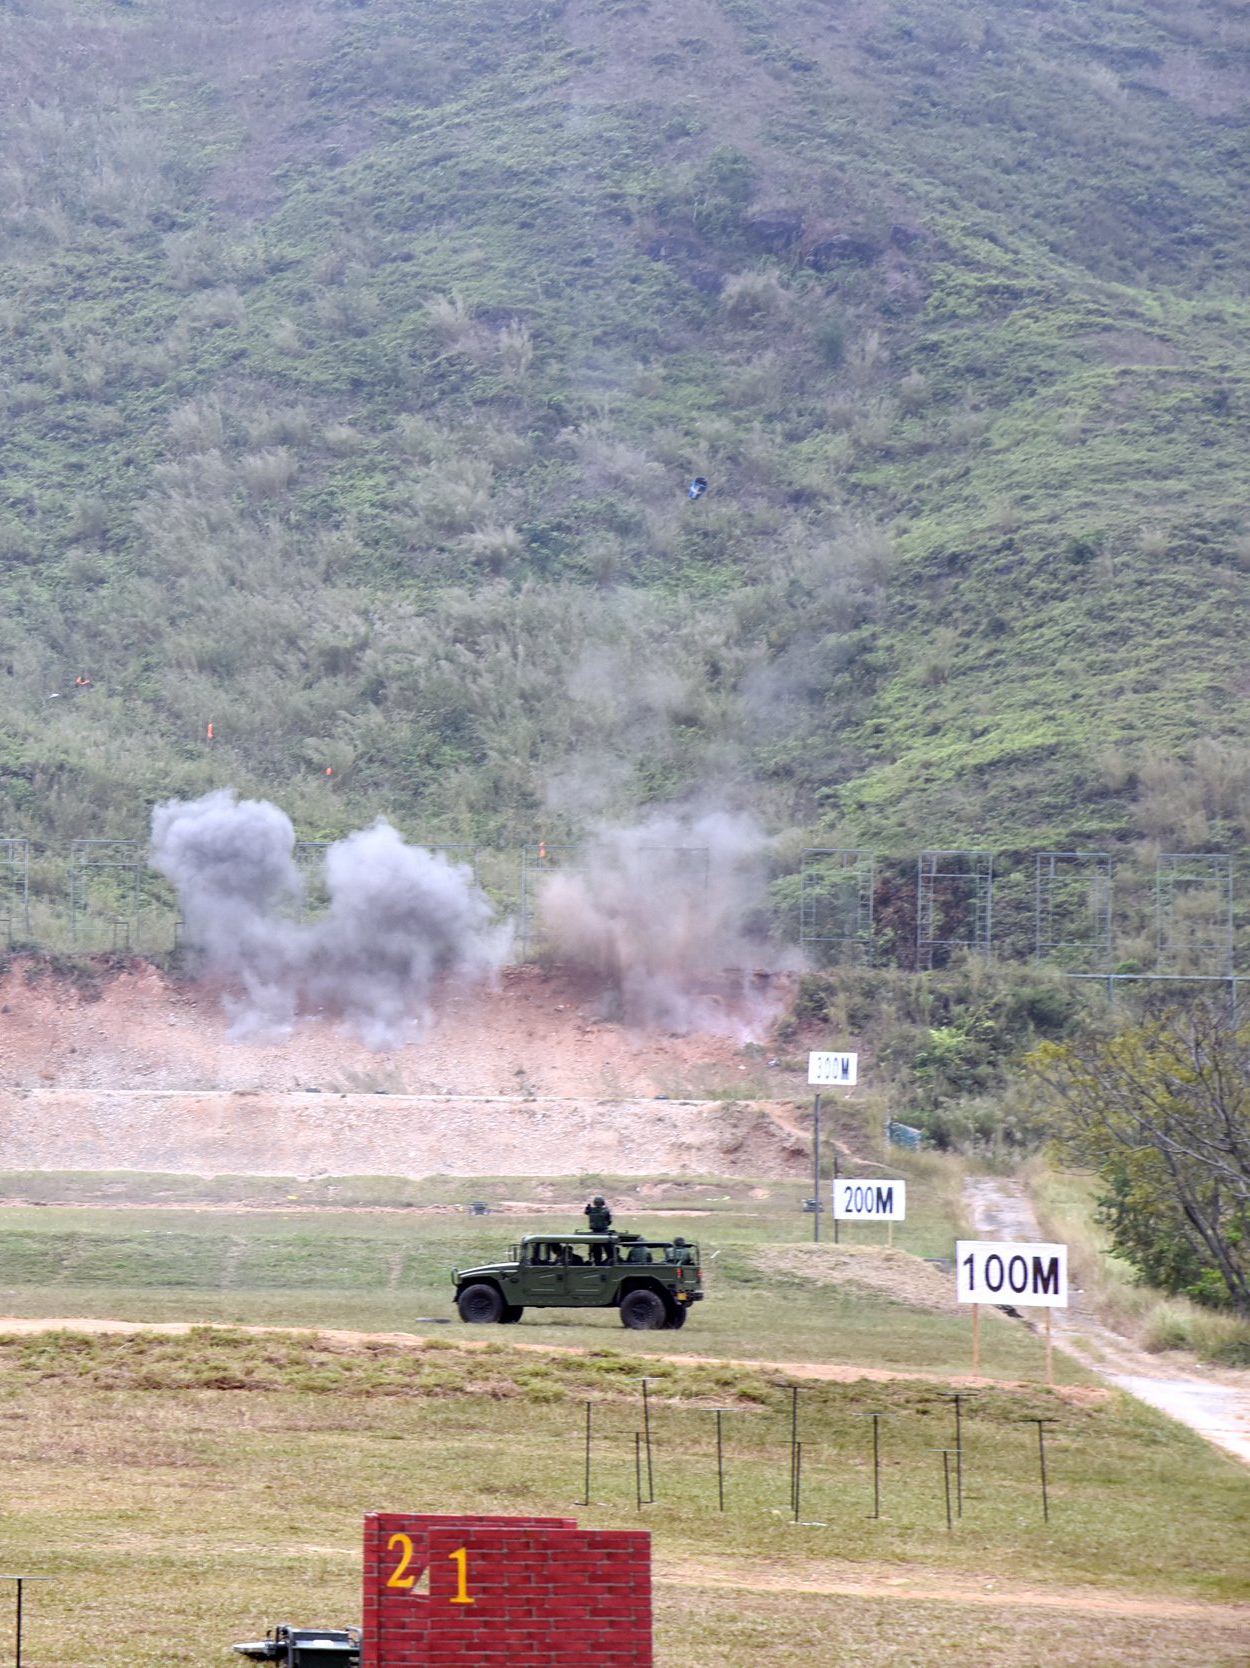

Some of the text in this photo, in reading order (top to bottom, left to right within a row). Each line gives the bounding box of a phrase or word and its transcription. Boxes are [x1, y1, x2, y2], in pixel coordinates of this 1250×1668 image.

[844, 1186, 893, 1214] 200M
[963, 1253, 1059, 1295] 100M
[386, 1533, 415, 1588] 2
[448, 1547, 475, 1603] 1
